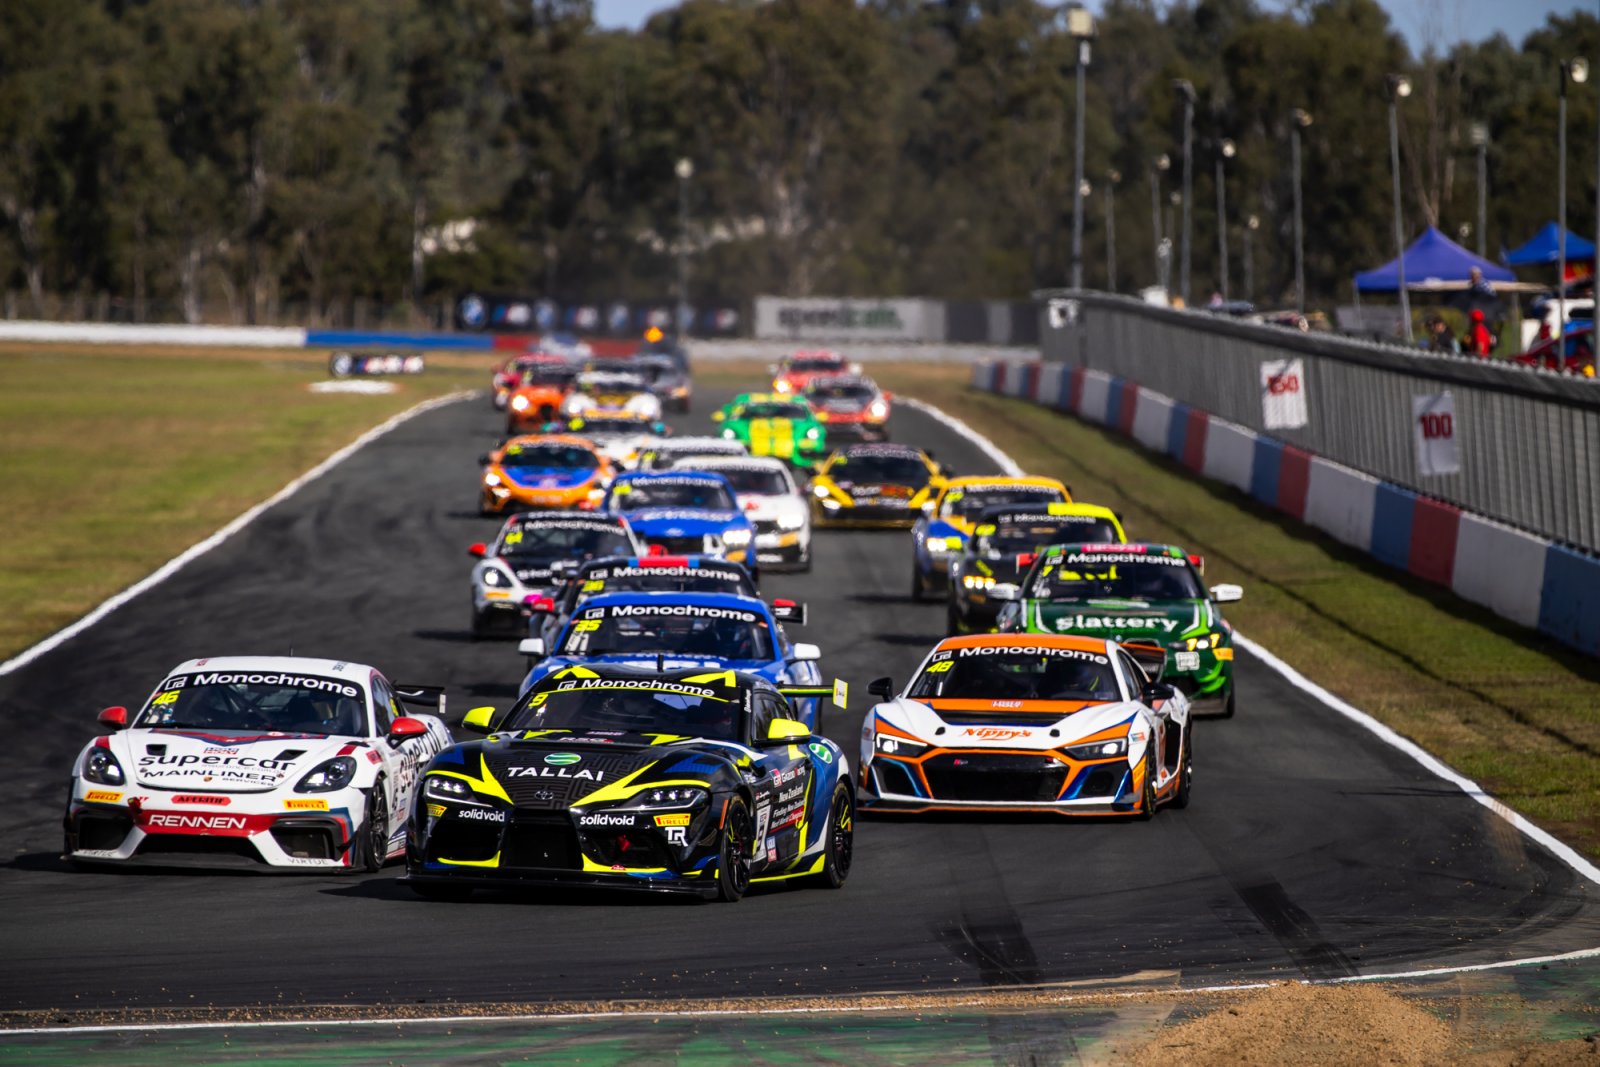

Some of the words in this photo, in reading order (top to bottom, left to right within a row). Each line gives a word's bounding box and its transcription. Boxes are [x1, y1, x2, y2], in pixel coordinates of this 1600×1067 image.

[1419, 411, 1453, 440] 100
[1067, 553, 1186, 566] Monochrome
[613, 566, 740, 581] Monochrome
[612, 605, 756, 622] Monochrome
[575, 619, 602, 632] 35
[1056, 614, 1179, 632] slattery
[959, 646, 1109, 665] Monochrome
[926, 661, 954, 673] 48
[193, 673, 357, 698] Monochrome
[581, 679, 715, 697] Monochrome
[152, 690, 180, 705] 46
[528, 693, 549, 707] 9
[138, 754, 296, 771] supercar
[144, 769, 277, 783] MAINLINER
[507, 766, 604, 782] TALLAI
[87, 791, 120, 801] PIRELLI
[287, 800, 326, 809] PIRELLI
[149, 814, 247, 829] RENNEN
[459, 808, 505, 822] solidvoid
[580, 814, 635, 826] solidvoid
[656, 816, 689, 825] PIRELLI
